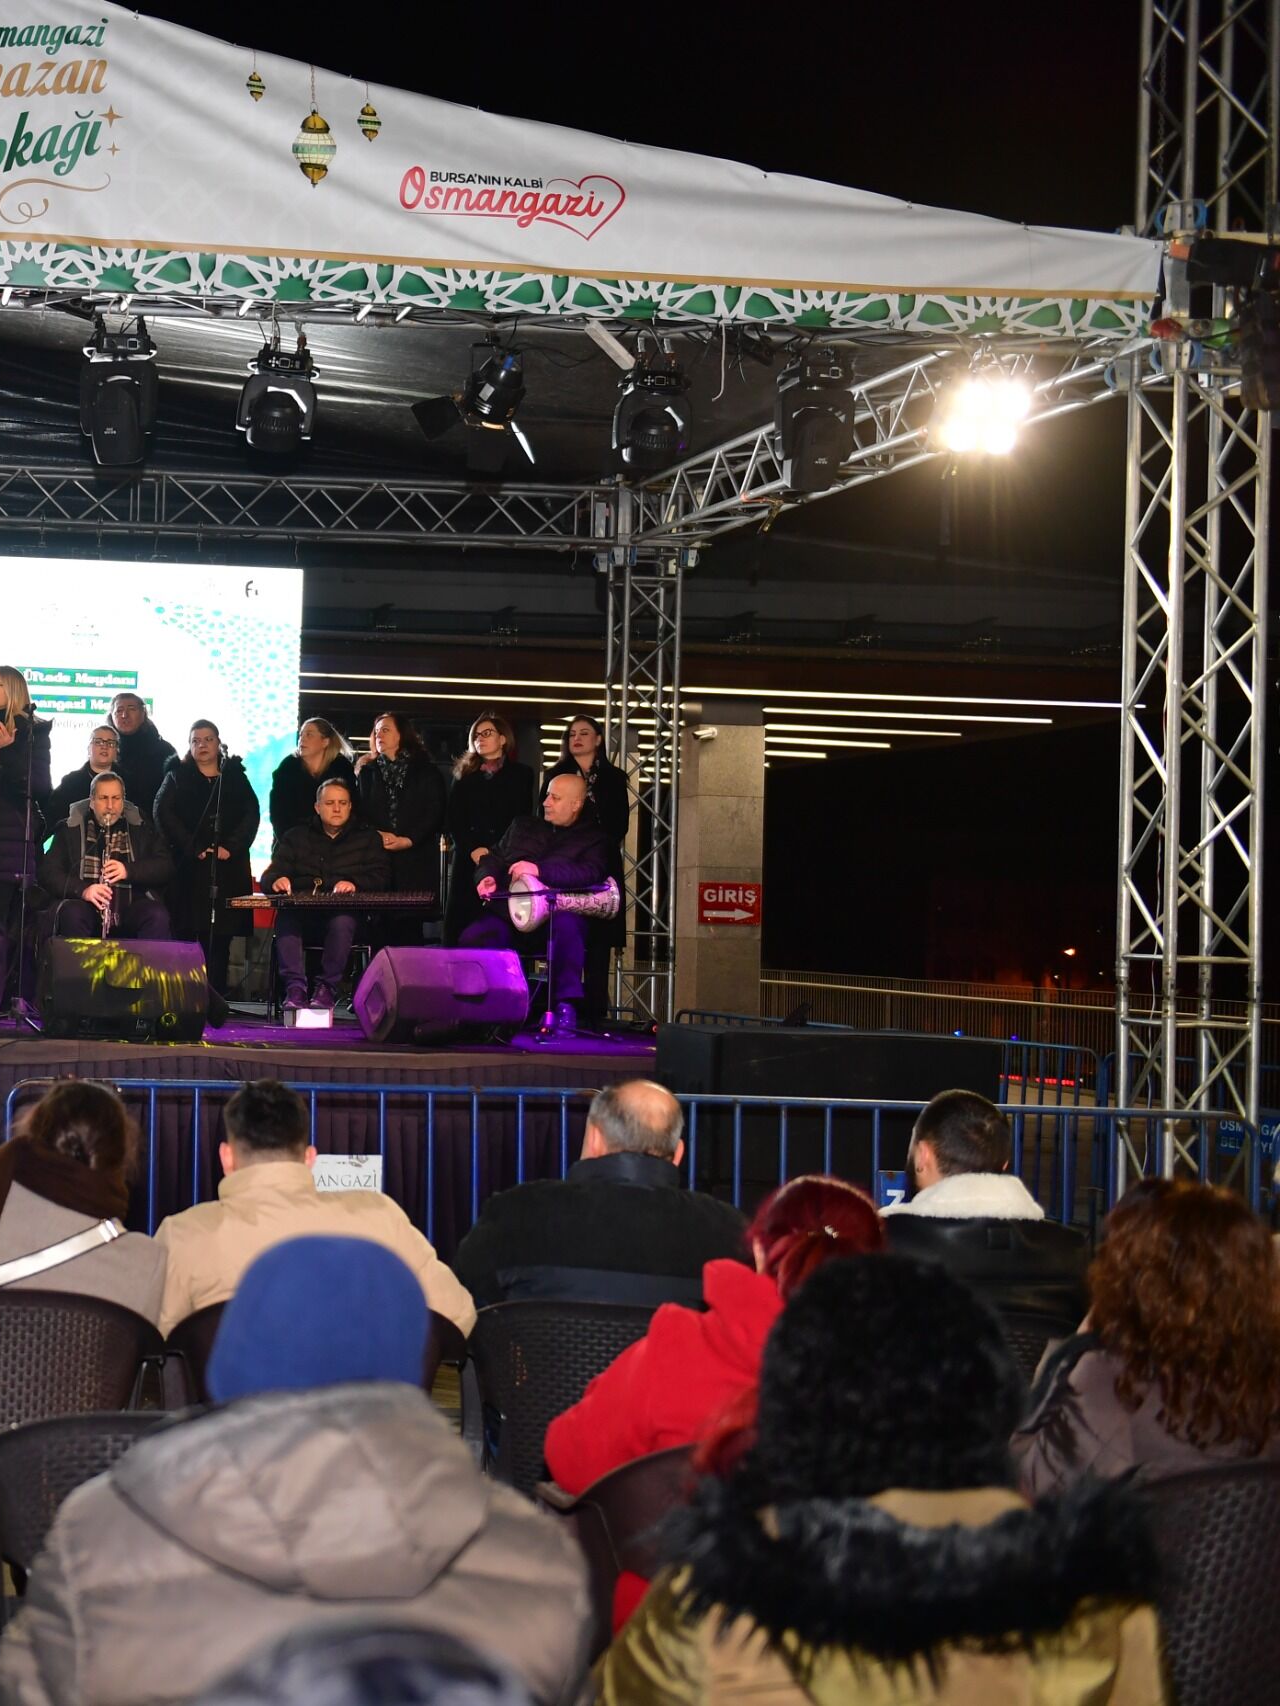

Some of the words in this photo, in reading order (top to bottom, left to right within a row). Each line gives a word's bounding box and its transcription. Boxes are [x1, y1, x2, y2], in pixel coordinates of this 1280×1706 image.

[429, 171, 504, 187] BURSA'NIN
[504, 174, 543, 189] KALBİ
[399, 165, 605, 229] Osmangazi
[703, 886, 757, 906] GİRİŞ
[316, 1169, 377, 1188] ANGAZİ
